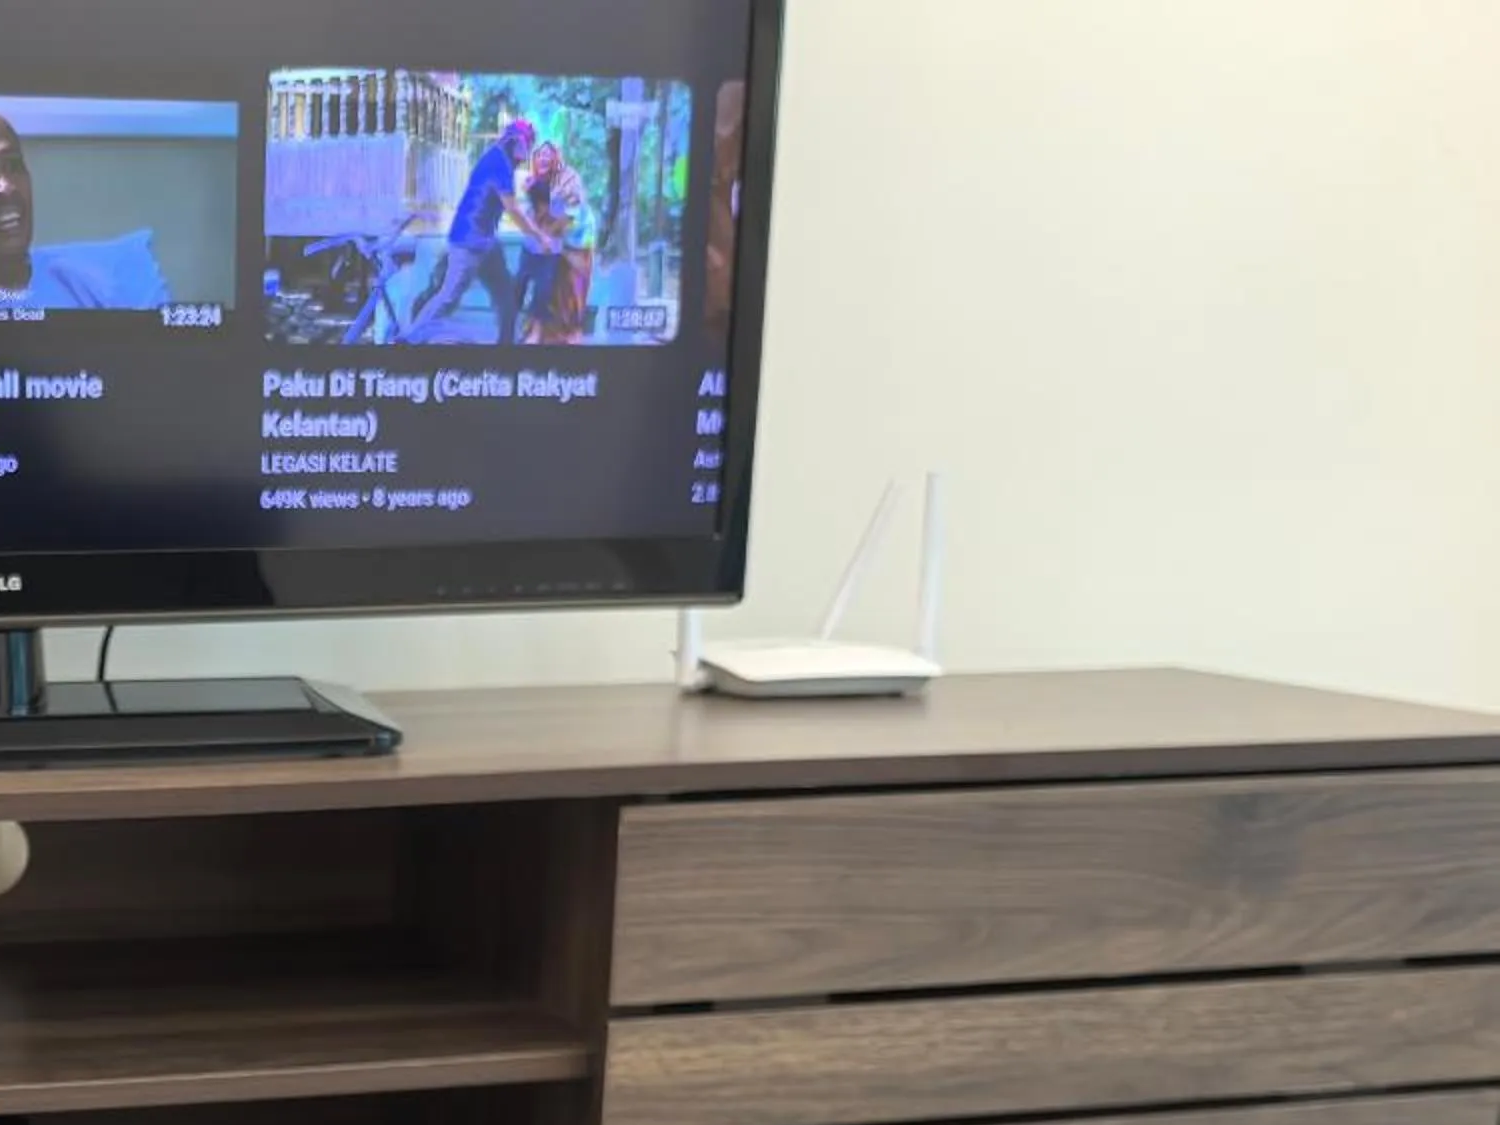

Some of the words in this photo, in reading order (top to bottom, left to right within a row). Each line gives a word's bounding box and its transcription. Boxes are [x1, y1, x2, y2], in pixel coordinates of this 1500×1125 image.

[25, 369, 104, 400] movie
[262, 370, 324, 399] Paku
[329, 370, 356, 398] Di
[360, 369, 429, 403] Tiang
[433, 368, 514, 403] (Cerita
[518, 370, 597, 403] Rakyat
[262, 410, 378, 442] Kelantan)
[261, 451, 327, 474] LEGASI
[329, 450, 399, 473] KELATE
[309, 489, 359, 509] views
[387, 489, 435, 511] years
[437, 489, 472, 511] ago
